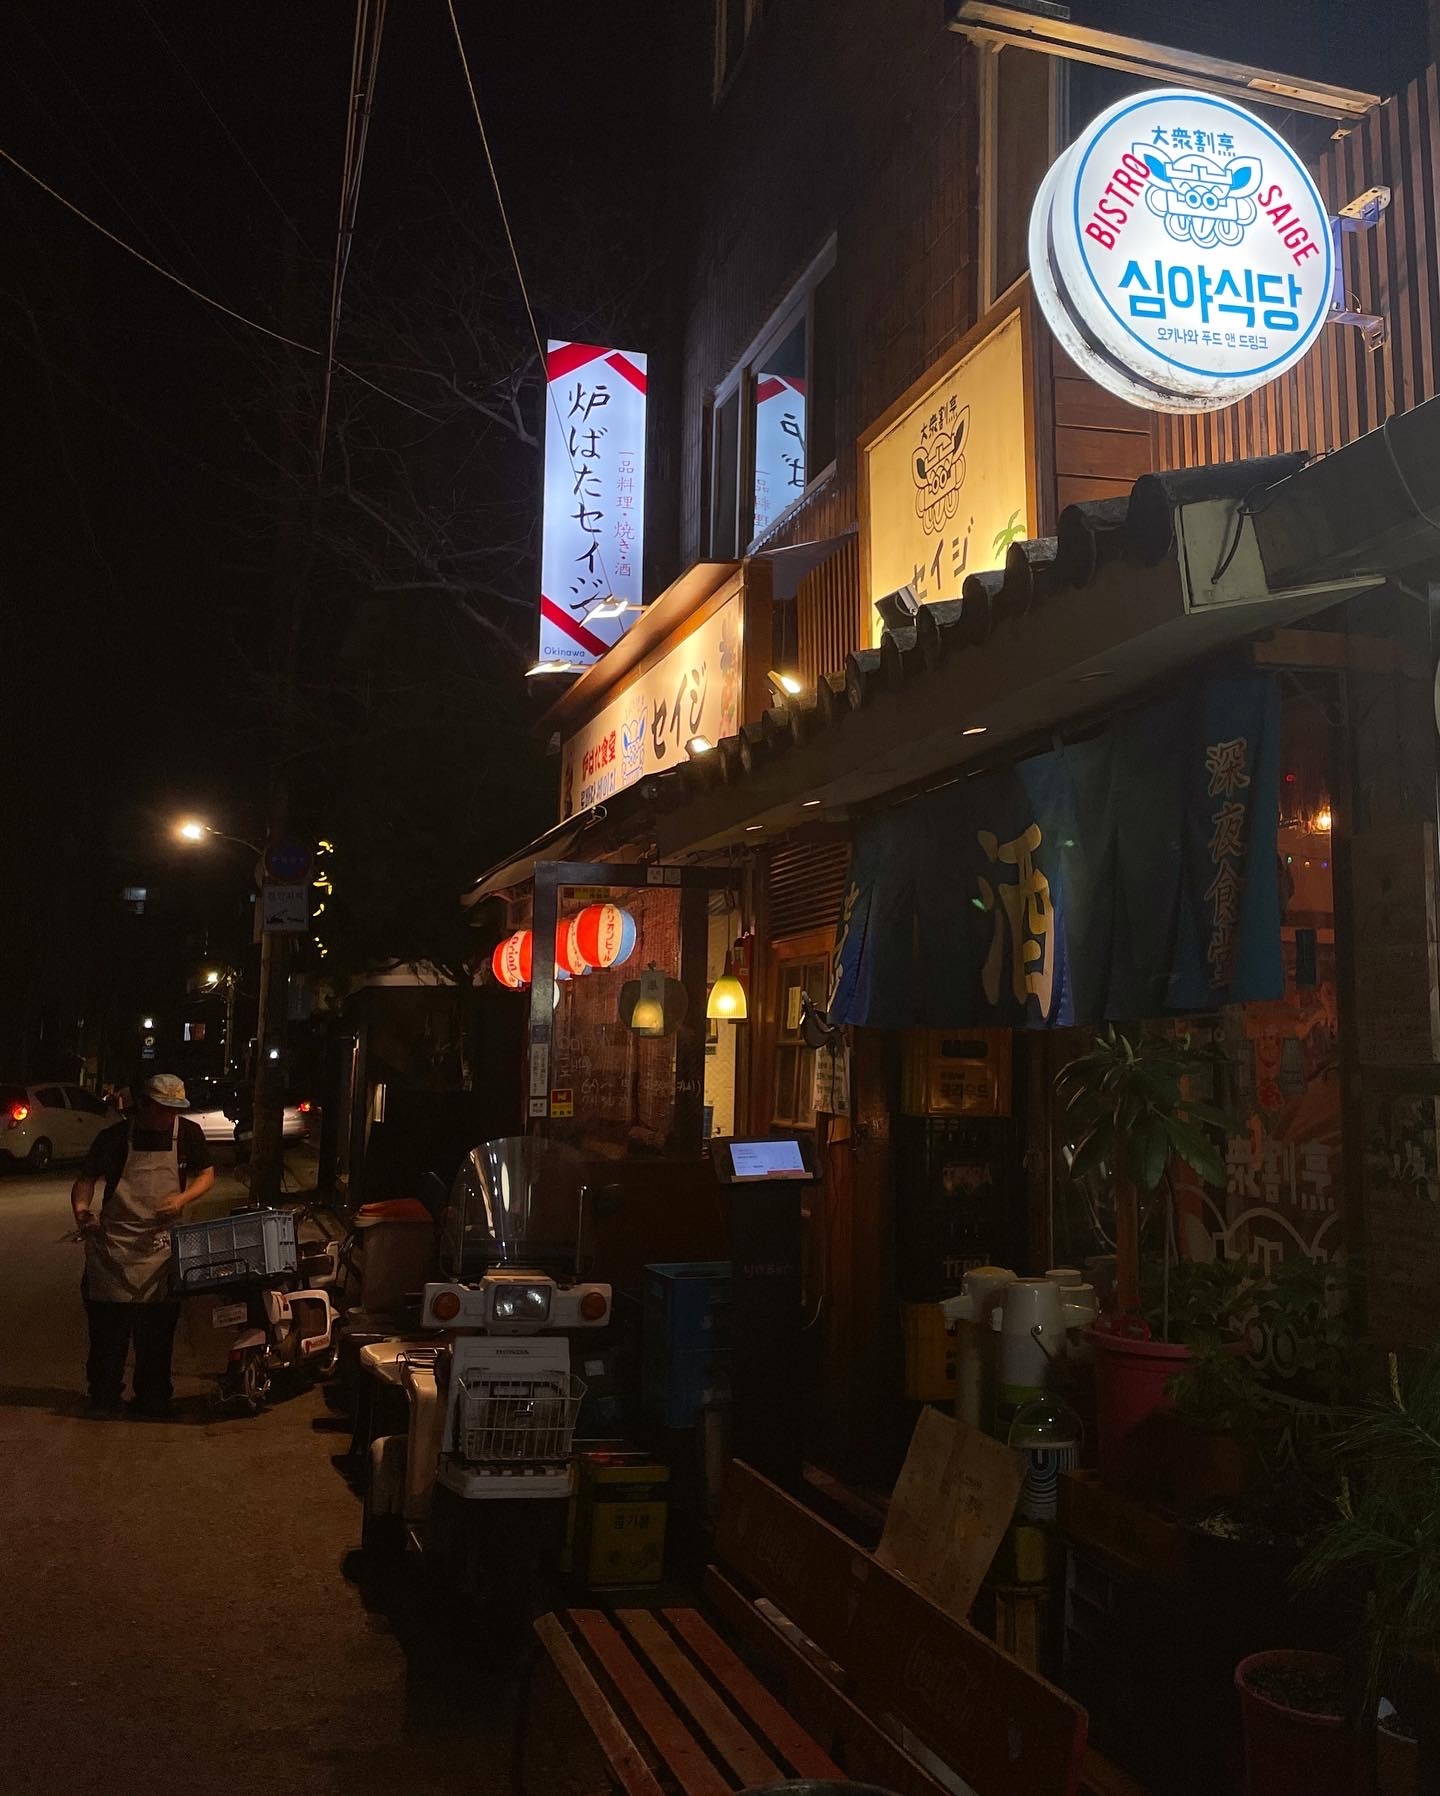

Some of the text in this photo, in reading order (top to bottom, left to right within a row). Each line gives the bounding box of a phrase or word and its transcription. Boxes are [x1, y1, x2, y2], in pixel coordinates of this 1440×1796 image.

[1151, 125, 1236, 156] 大衆割烹
[1085, 153, 1151, 250] BISTRO
[1257, 184, 1320, 266] SAIGE
[1118, 260, 1302, 331] 심야식당
[1157, 327, 1268, 350] 오키나와 푸드 앤 드링크
[543, 646, 585, 657] Okinawa
[651, 661, 708, 759] セイジ
[1204, 736, 1251, 990] 深夜食堂
